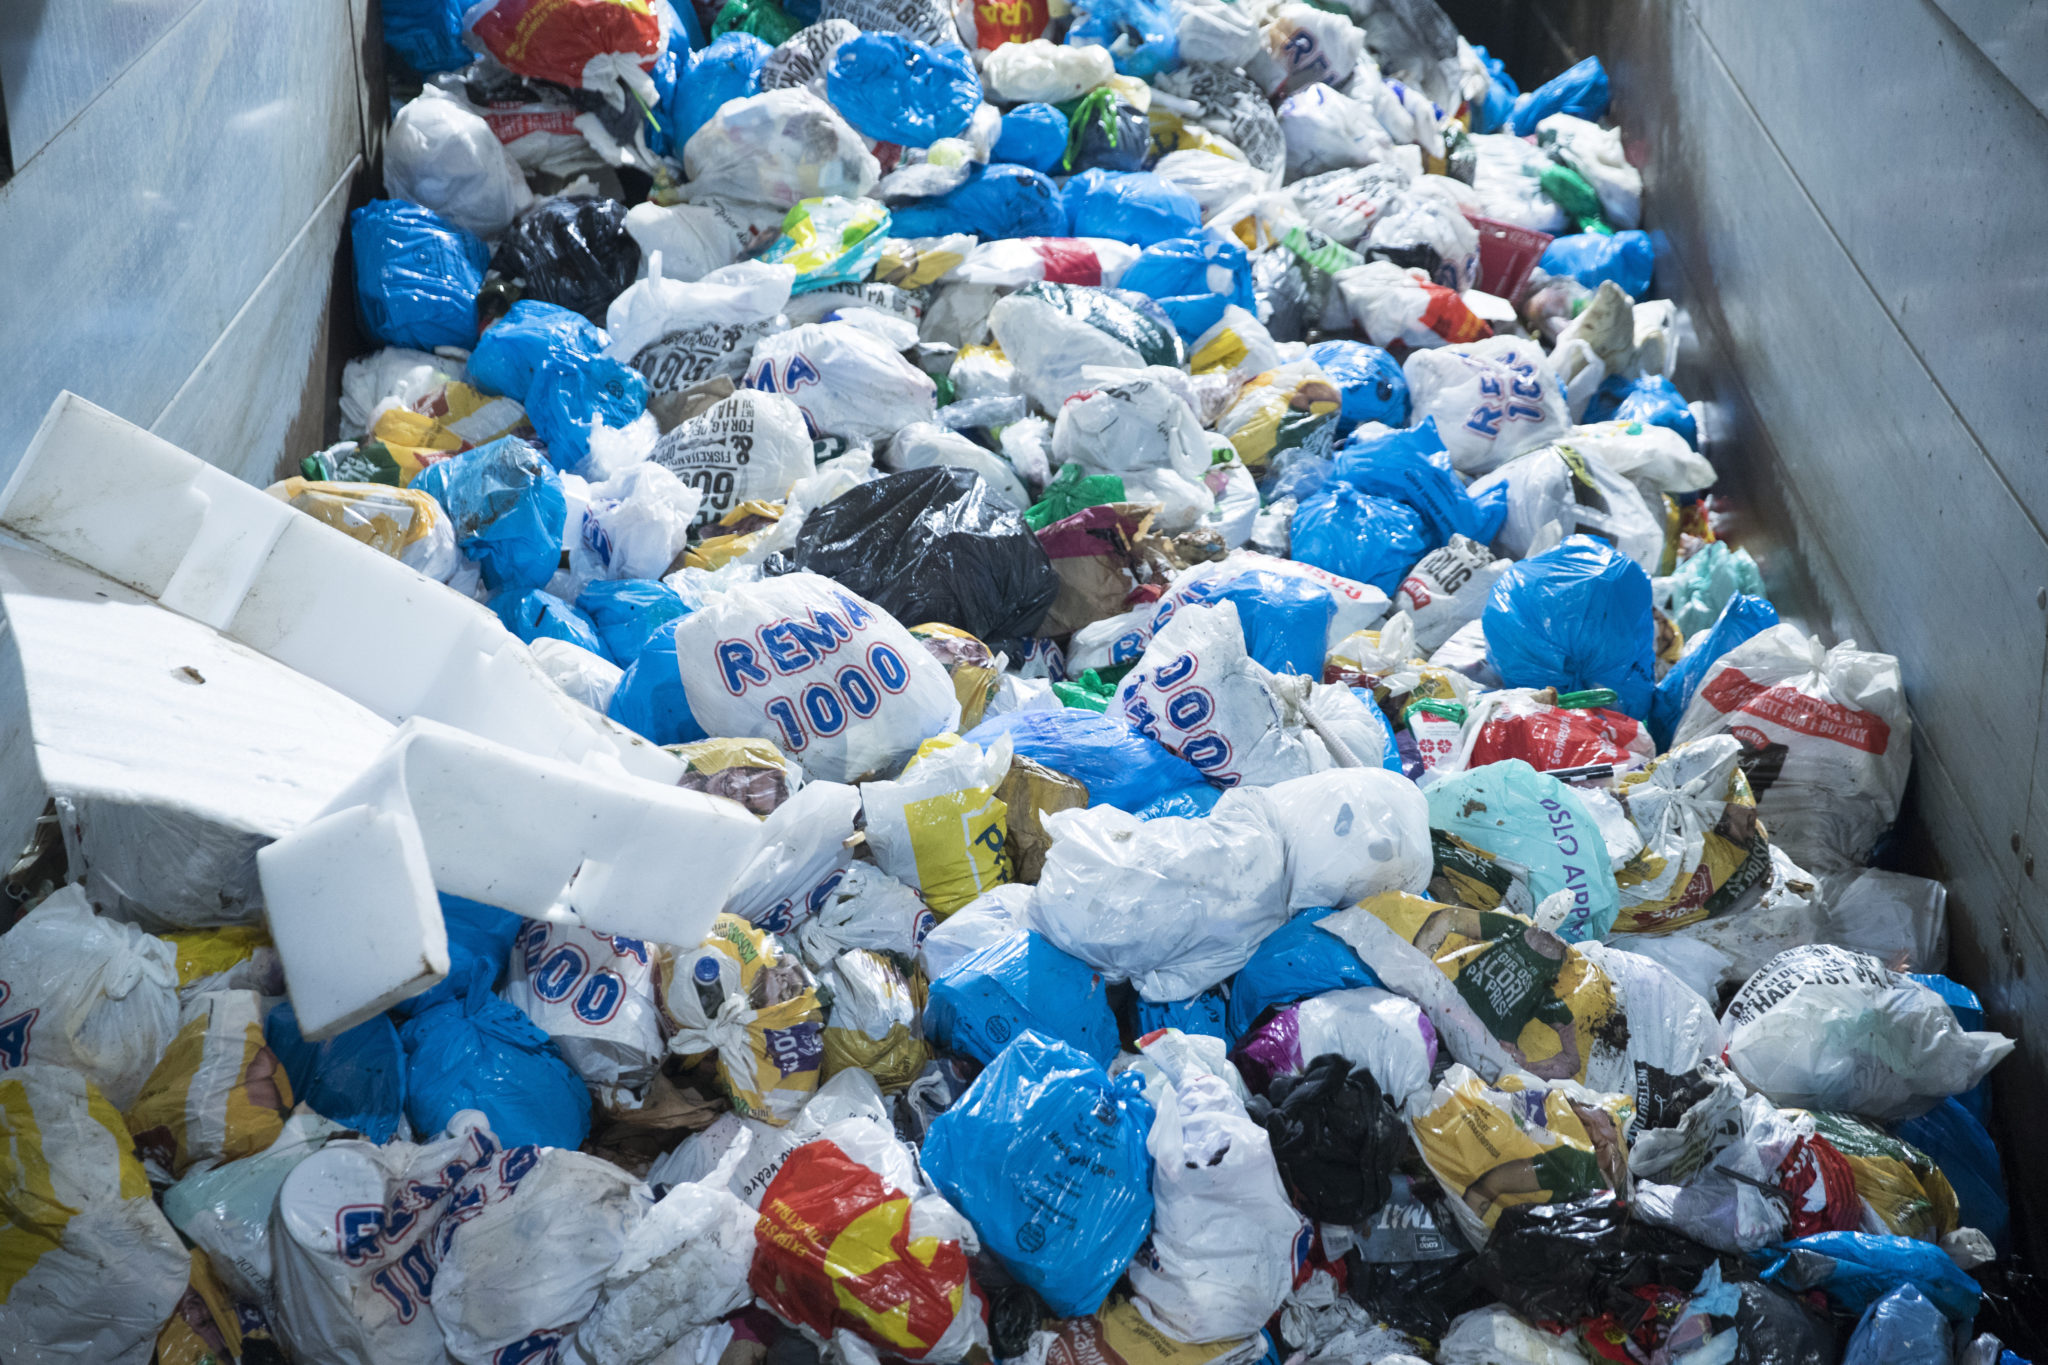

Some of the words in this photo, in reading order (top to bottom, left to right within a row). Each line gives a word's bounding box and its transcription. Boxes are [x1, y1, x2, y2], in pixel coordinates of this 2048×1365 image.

[714, 590, 878, 697] REMA
[765, 641, 911, 753] 1000
[1734, 728, 1766, 746] MENY
[1818, 721, 1869, 744] BUTIKK
[1539, 798, 1580, 857] OSLO
[1753, 977, 1798, 1015] HAR
